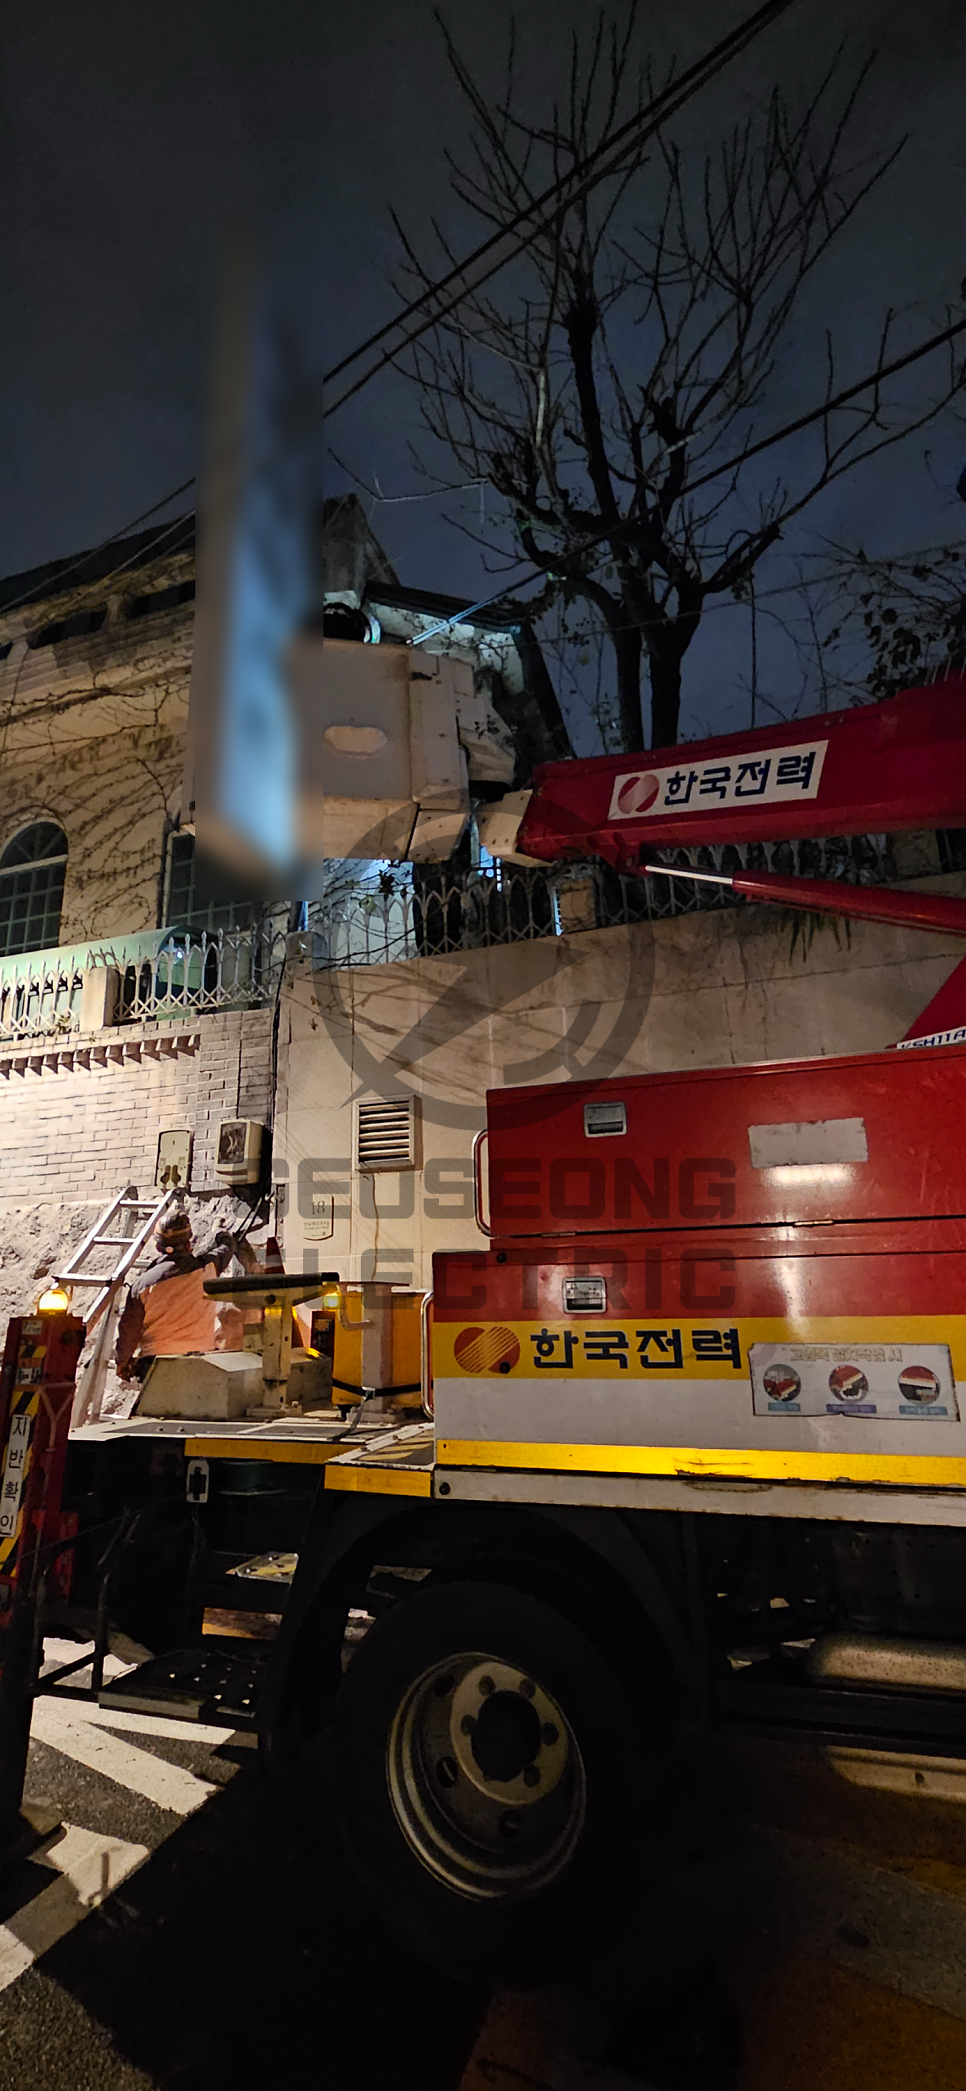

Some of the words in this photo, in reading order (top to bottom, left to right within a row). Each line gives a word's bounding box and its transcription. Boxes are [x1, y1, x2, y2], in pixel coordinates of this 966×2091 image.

[664, 751, 816, 806] 한국전력
[309, 1200, 325, 1214] 18
[530, 1328, 742, 1369] 한국전력
